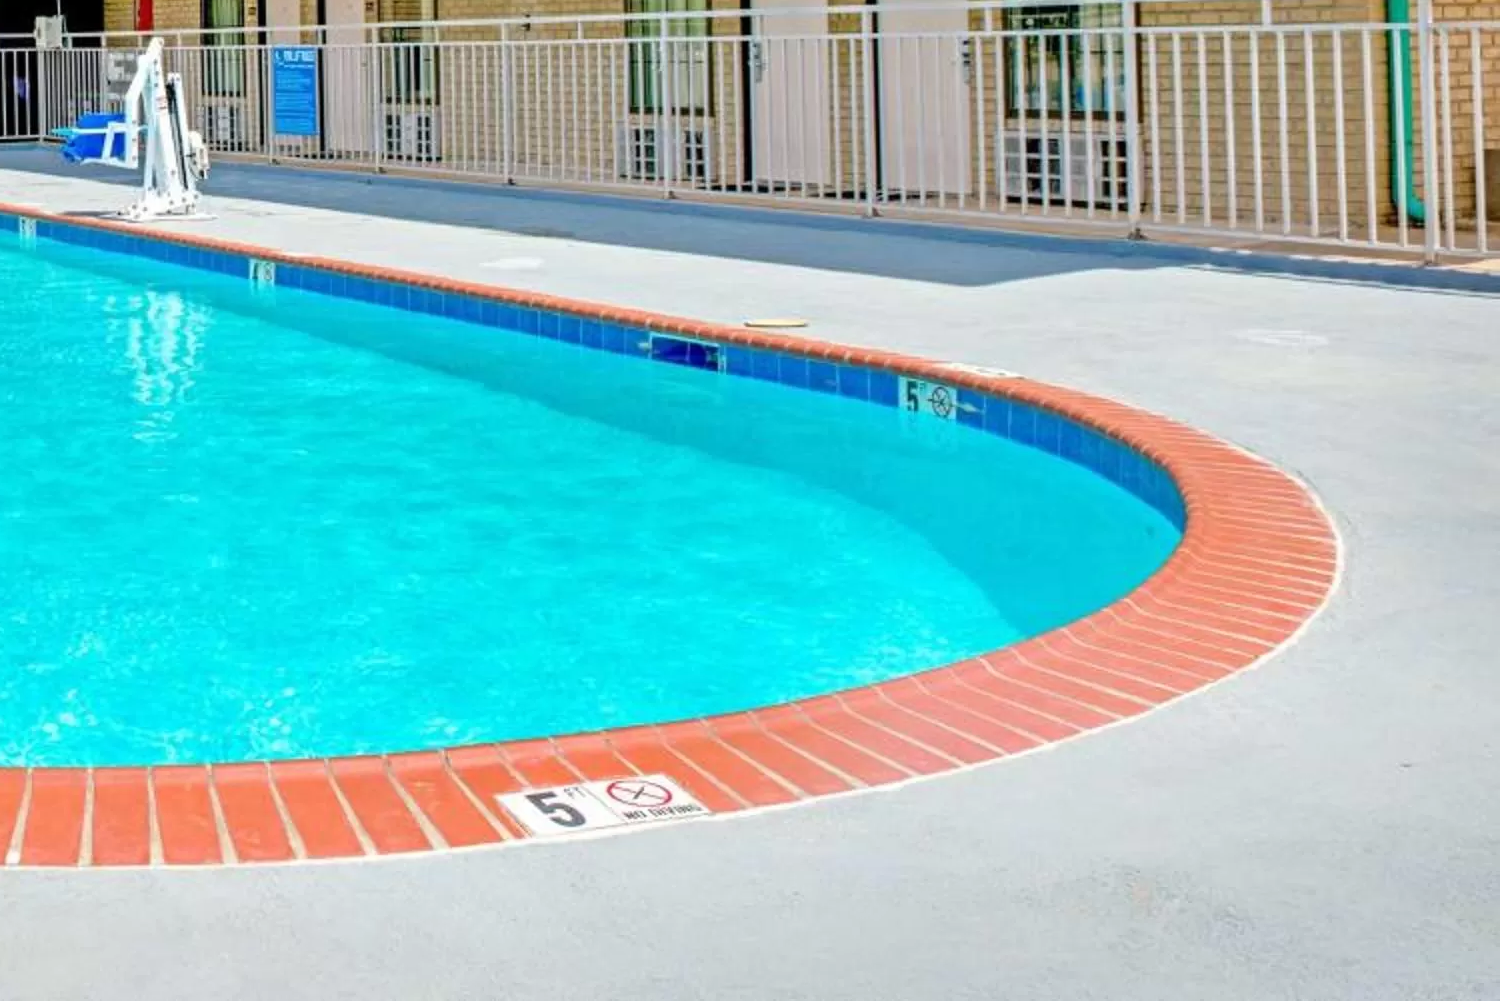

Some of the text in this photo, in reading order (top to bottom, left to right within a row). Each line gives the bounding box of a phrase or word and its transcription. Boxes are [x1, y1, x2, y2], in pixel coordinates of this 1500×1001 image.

[906, 380, 919, 412] 5
[524, 786, 587, 828] 5 FT
[622, 804, 703, 820] NO DIVING
